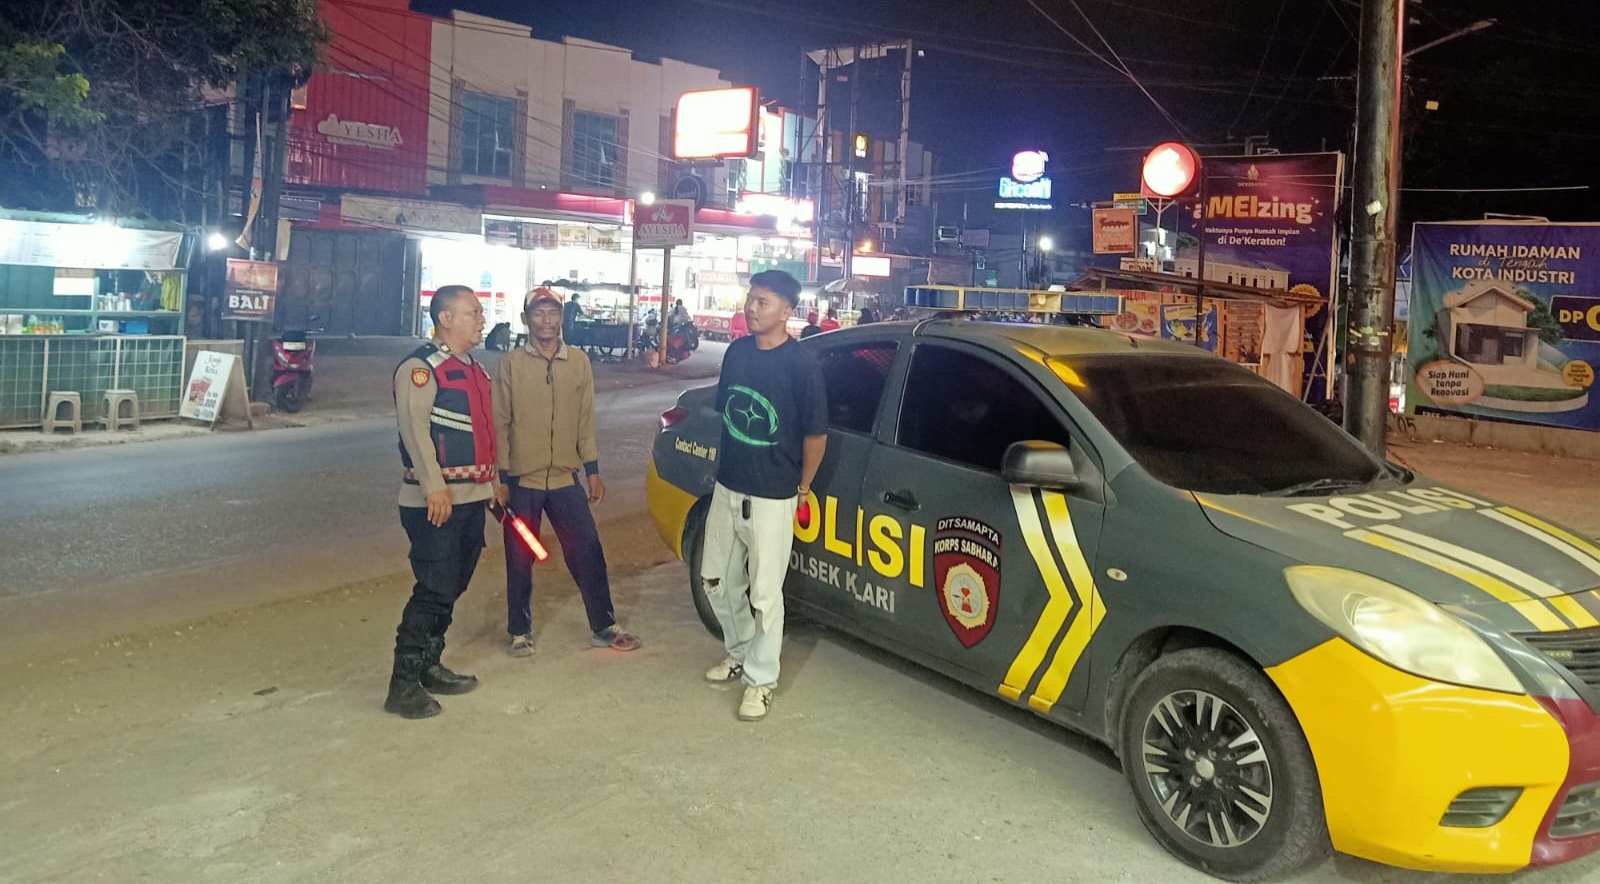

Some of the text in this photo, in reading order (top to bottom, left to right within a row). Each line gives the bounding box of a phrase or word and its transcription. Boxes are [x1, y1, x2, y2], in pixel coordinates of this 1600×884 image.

[637, 222, 687, 236] AYESHA
[1217, 235, 1286, 246] di De'Keraton!
[1450, 244, 1580, 259] RUMAH IDAMAN
[1478, 256, 1548, 270] di Tengah
[1452, 266, 1575, 284] KOTA INDUSTRI
[229, 295, 270, 310] BALI
[1559, 309, 1584, 324] DP
[1428, 370, 1470, 380] Siap Huni
[1431, 387, 1469, 396] Renovasi
[1436, 380, 1462, 389] tanpa
[675, 436, 693, 454] Contact
[692, 441, 708, 459] Center
[1285, 486, 1496, 529] POLISI
[793, 489, 926, 588] OLISI
[938, 518, 1000, 546] DITSAMAPTA
[934, 538, 999, 571] KORPS SABHARA
[788, 549, 841, 588] OLSEK
